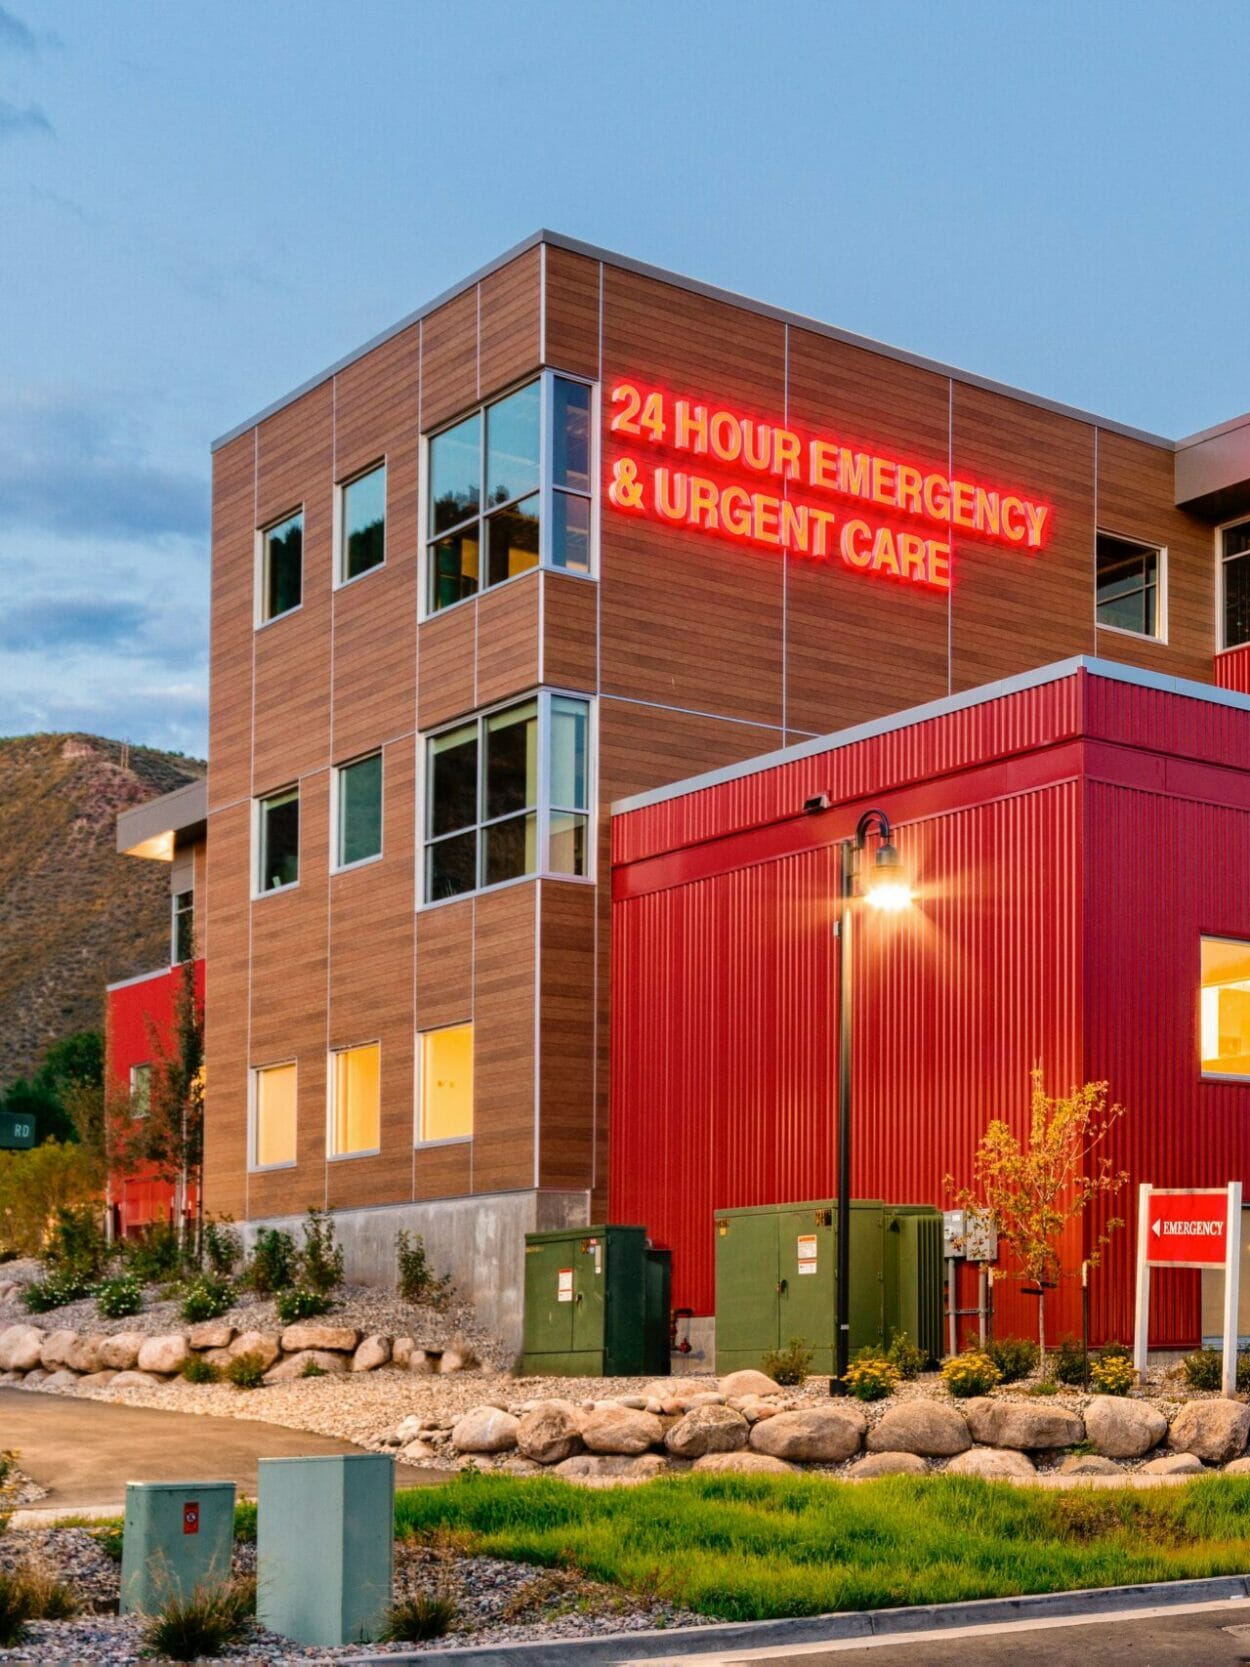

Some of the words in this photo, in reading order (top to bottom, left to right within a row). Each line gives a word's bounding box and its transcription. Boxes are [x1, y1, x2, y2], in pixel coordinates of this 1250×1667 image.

[610, 384, 666, 441] 24
[674, 400, 801, 480] HOUR
[810, 440, 1048, 547] EMERGENCY
[609, 457, 645, 510] &
[654, 467, 835, 557] URGENT
[840, 519, 950, 588] CARE
[14, 1123, 30, 1137] RD
[1163, 1221, 1224, 1235] EMERGENCY
